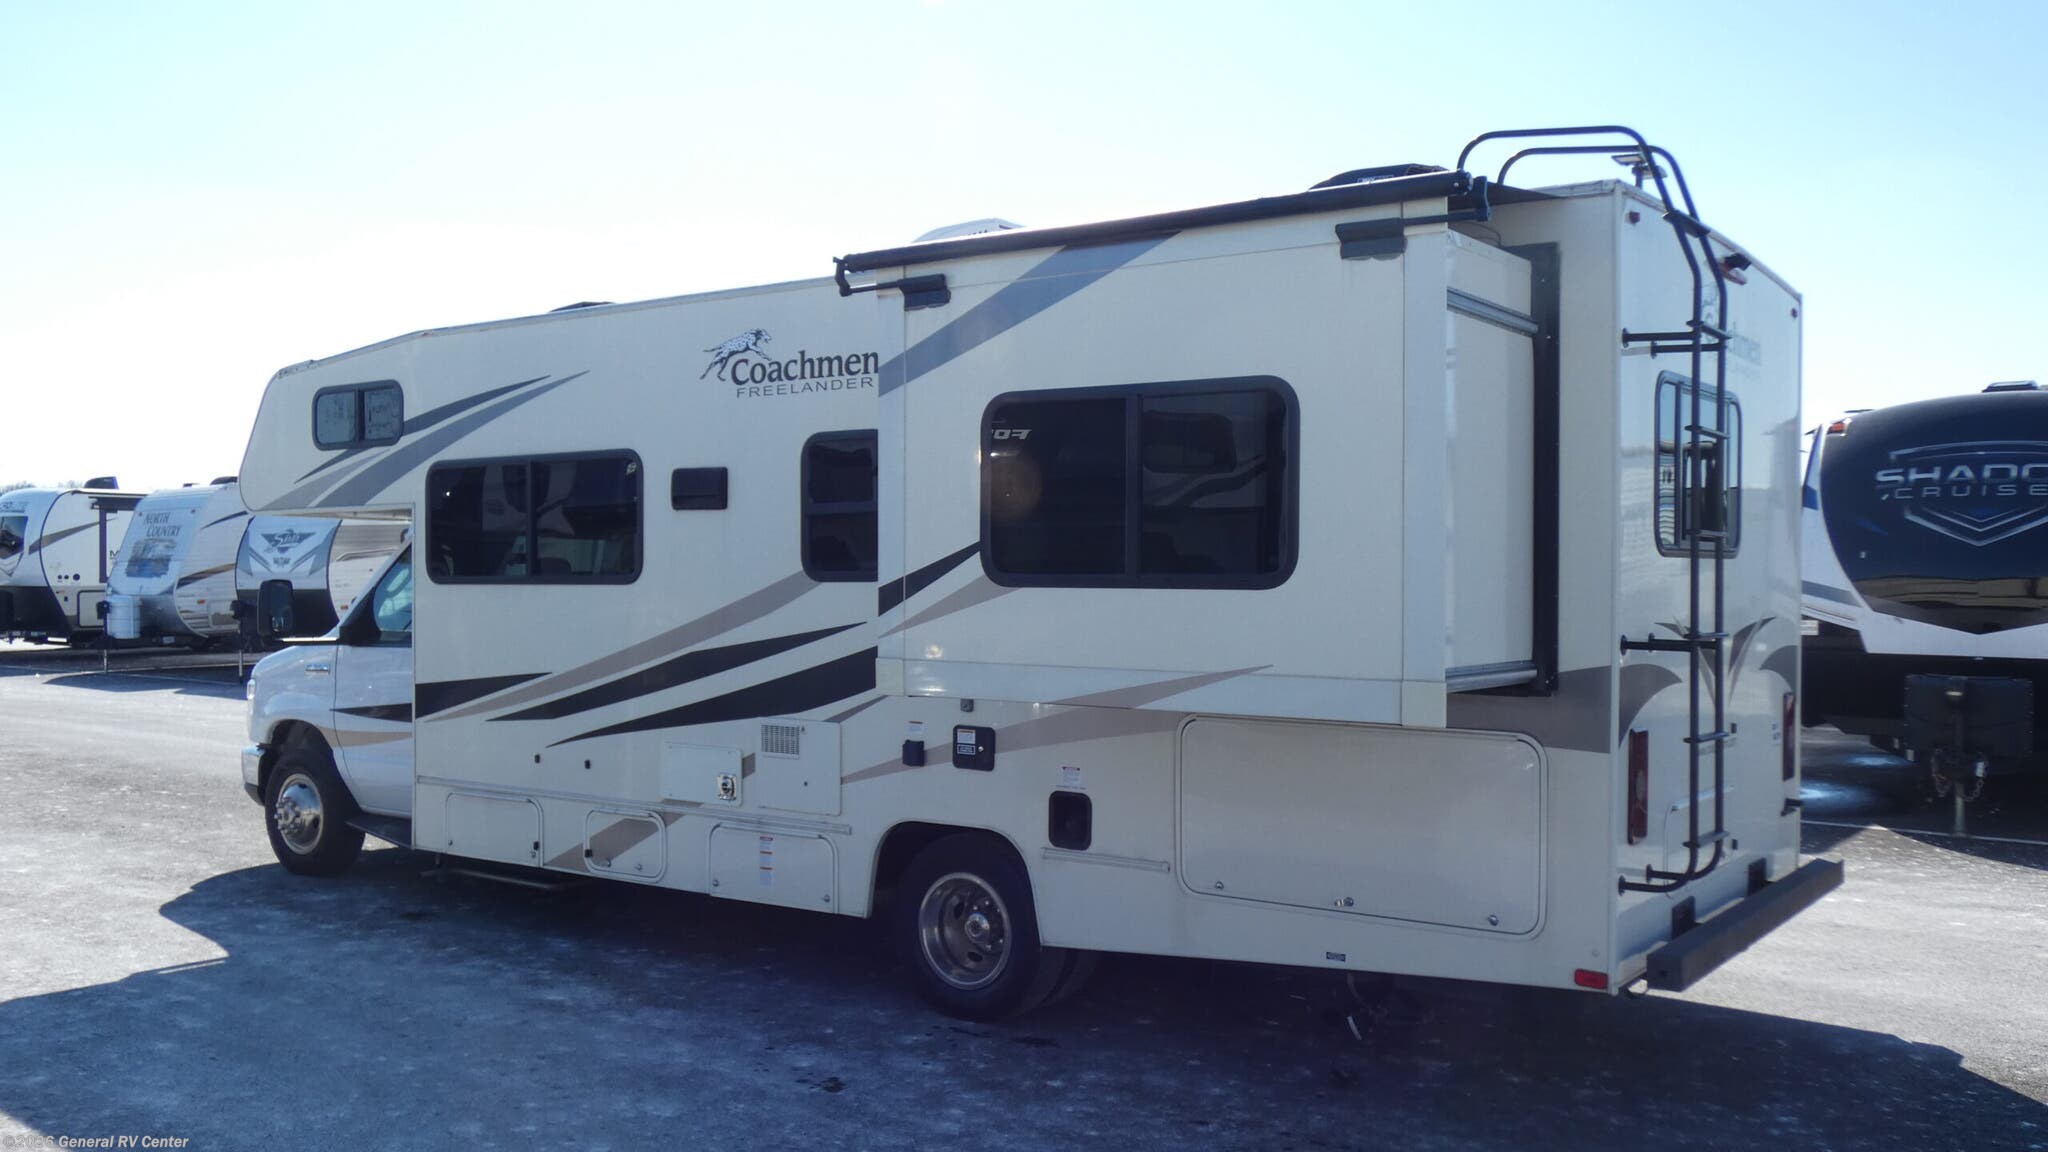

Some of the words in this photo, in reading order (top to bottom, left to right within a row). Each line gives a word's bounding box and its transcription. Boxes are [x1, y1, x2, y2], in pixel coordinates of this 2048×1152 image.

[731, 350, 879, 386] Coachmen
[736, 377, 874, 399] FREELANDER
[145, 512, 171, 524] NORTH
[146, 525, 182, 537] COUNTRY
